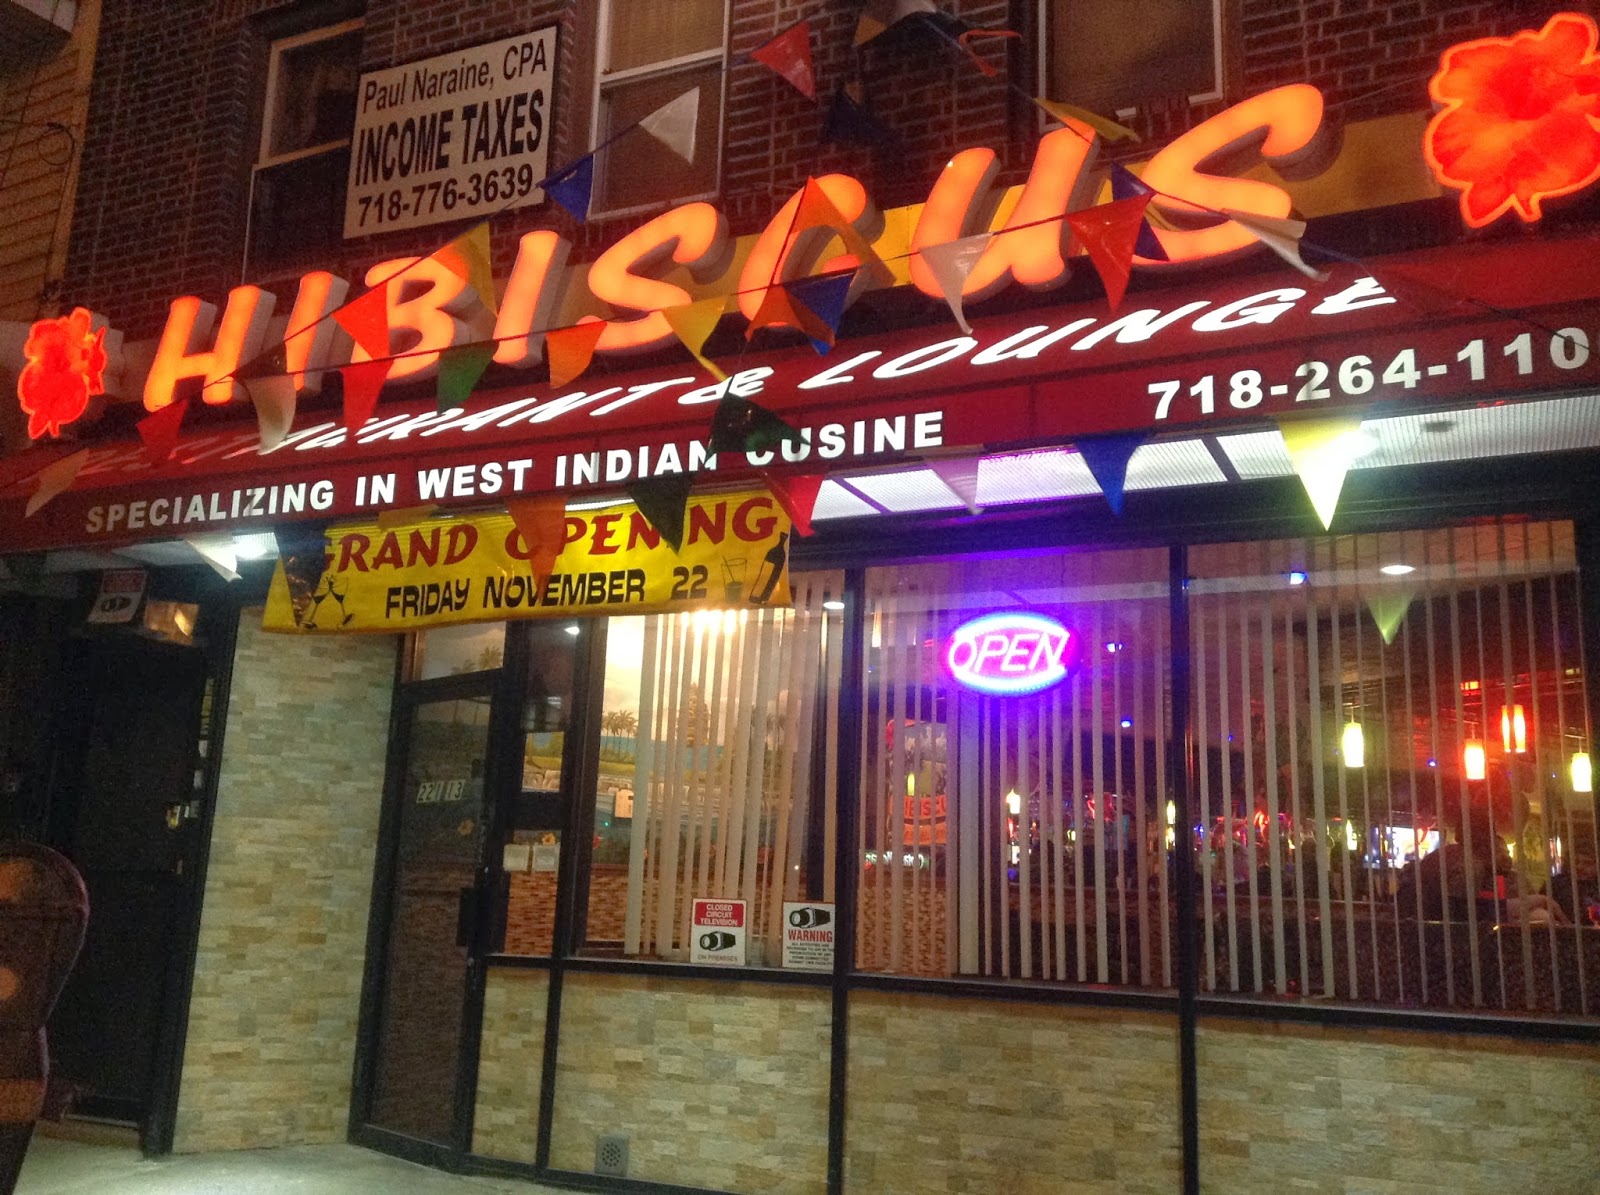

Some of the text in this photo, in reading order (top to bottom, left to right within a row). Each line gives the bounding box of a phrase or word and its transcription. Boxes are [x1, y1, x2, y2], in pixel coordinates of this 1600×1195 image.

[363, 38, 547, 113] Paul Naraine, CPA
[355, 88, 544, 186] INCOME TAXES
[358, 163, 533, 228] 718-776-3639
[143, 83, 1324, 412] HIBISCUS
[798, 276, 1398, 389] LOUNGE
[1147, 326, 1590, 420] 718-264-110
[86, 480, 334, 534] SPECIALIZING
[355, 473, 396, 508] IN
[418, 459, 533, 500] WEST
[555, 439, 717, 488] INDIAN
[325, 497, 778, 573] RAND OPENNG
[385, 564, 709, 619] FRIDAY NOVEMBER 22
[949, 631, 1071, 674] OPEN
[700, 918, 738, 926] TELEVISION
[706, 903, 733, 911] CLOSED
[788, 929, 833, 943] WARNING
